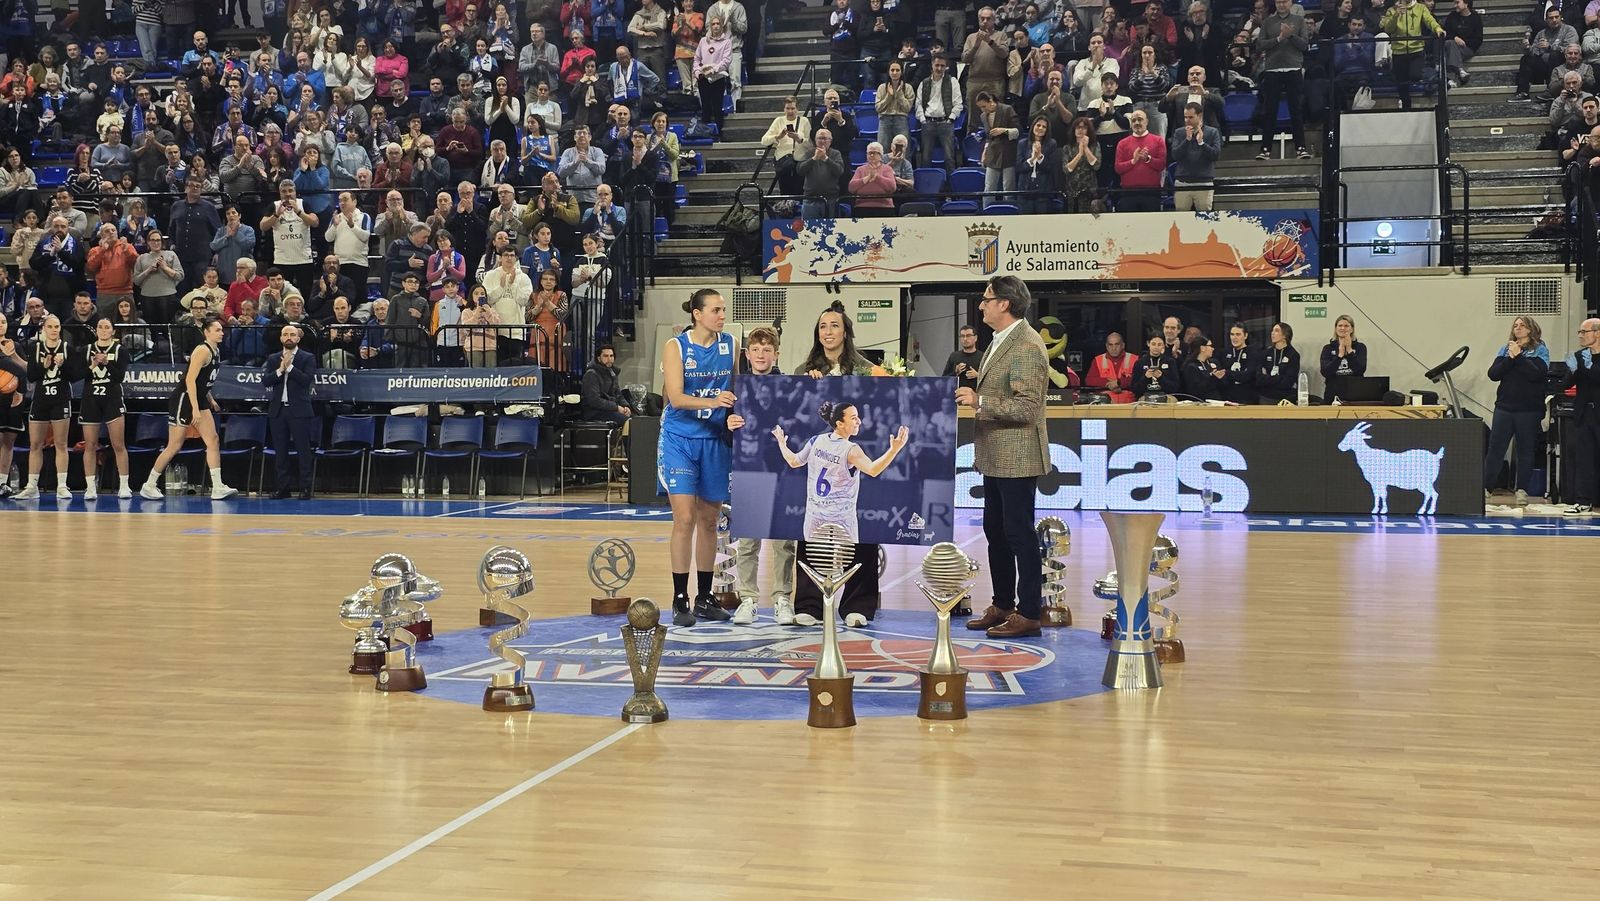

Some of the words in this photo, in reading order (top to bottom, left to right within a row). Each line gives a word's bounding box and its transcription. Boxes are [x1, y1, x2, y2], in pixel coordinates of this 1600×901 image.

[289, 224, 294, 233] 6
[1006, 239, 1099, 256] Ayuntamiento
[1006, 258, 1021, 271] de
[1026, 257, 1100, 271] Salamanca
[1302, 294, 1325, 302] SALIDA
[122, 371, 183, 383] ALAMANC
[236, 372, 265, 384] CAS
[313, 371, 347, 385] LEÓN
[388, 374, 538, 391] perfumeriasavenida.com
[45, 386, 58, 396] 16
[93, 386, 107, 396] 22
[816, 467, 832, 497] 6
[460, 658, 1005, 692] AVENDA
